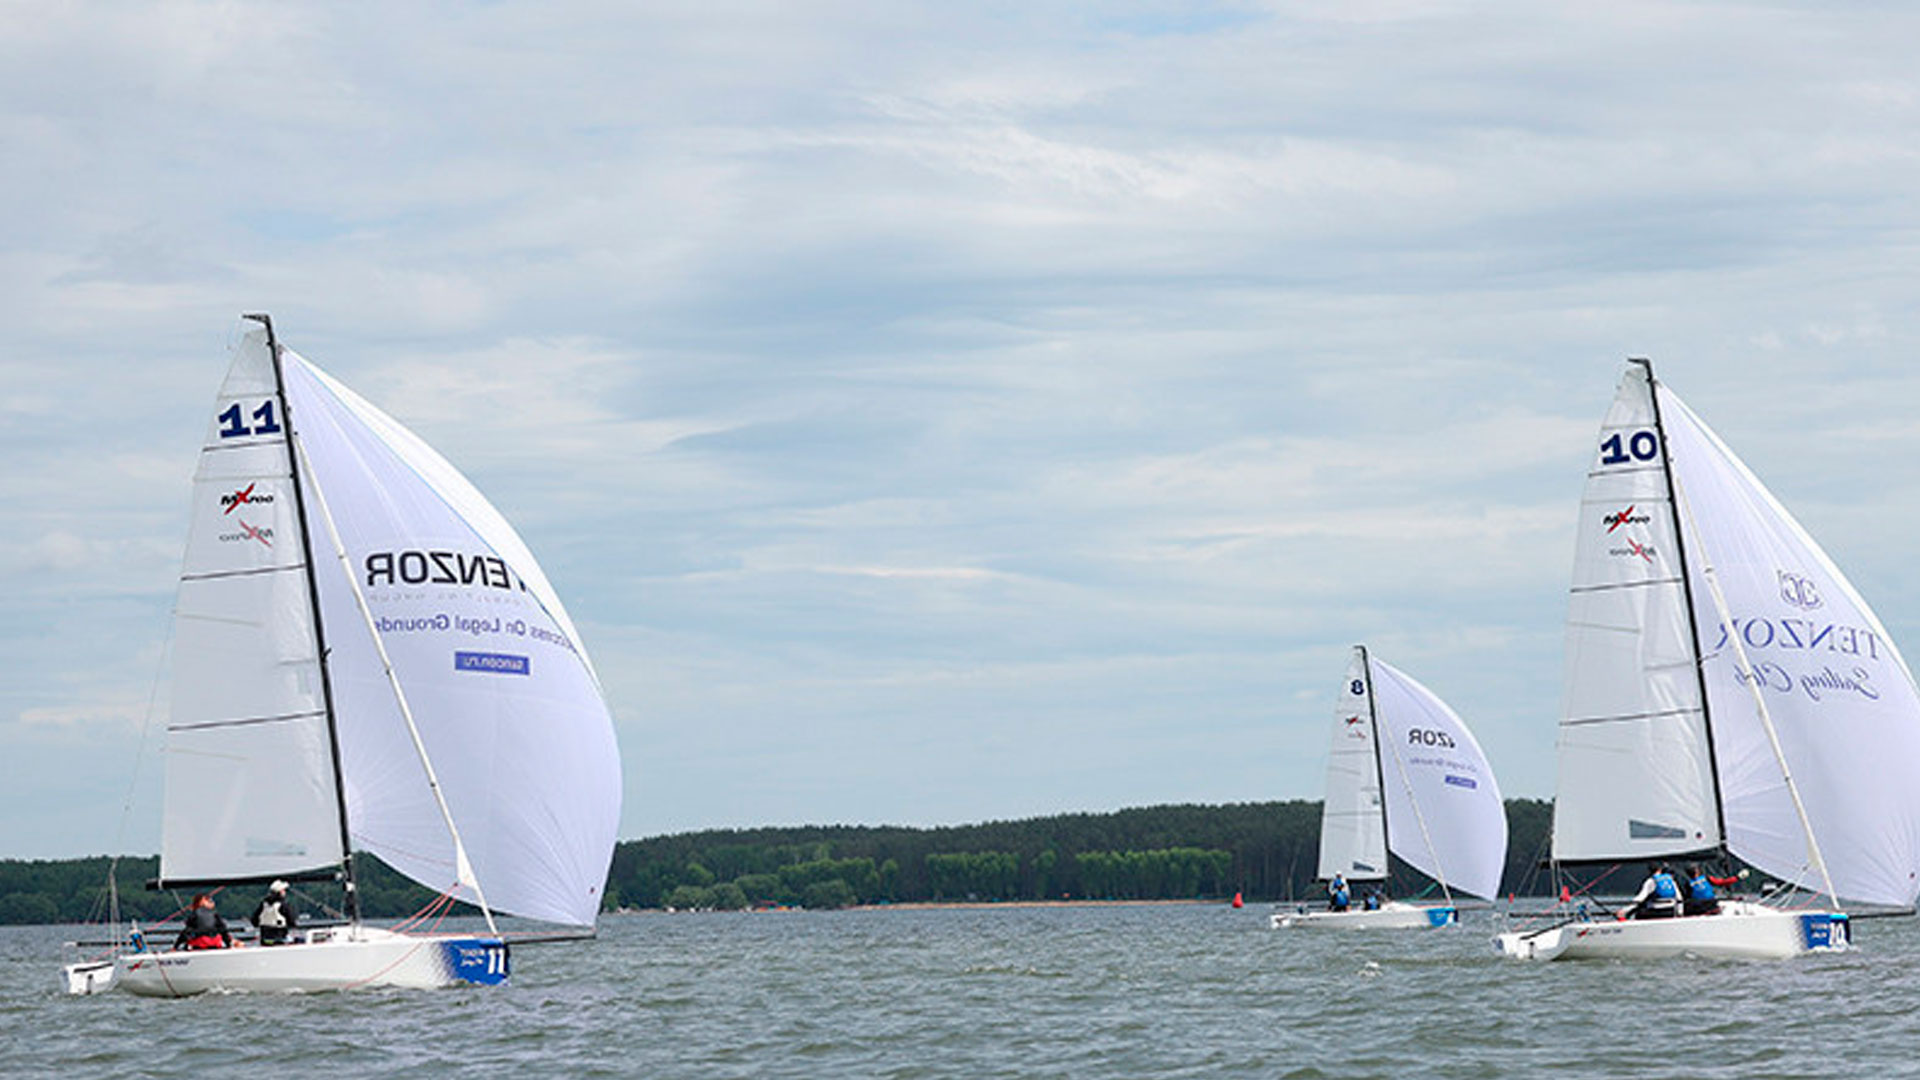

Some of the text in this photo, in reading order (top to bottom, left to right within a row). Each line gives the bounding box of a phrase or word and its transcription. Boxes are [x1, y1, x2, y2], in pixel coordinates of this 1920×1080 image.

[218, 400, 281, 438] 11
[1600, 431, 1658, 465] 10
[1351, 680, 1365, 696] 8
[488, 948, 505, 975] 11
